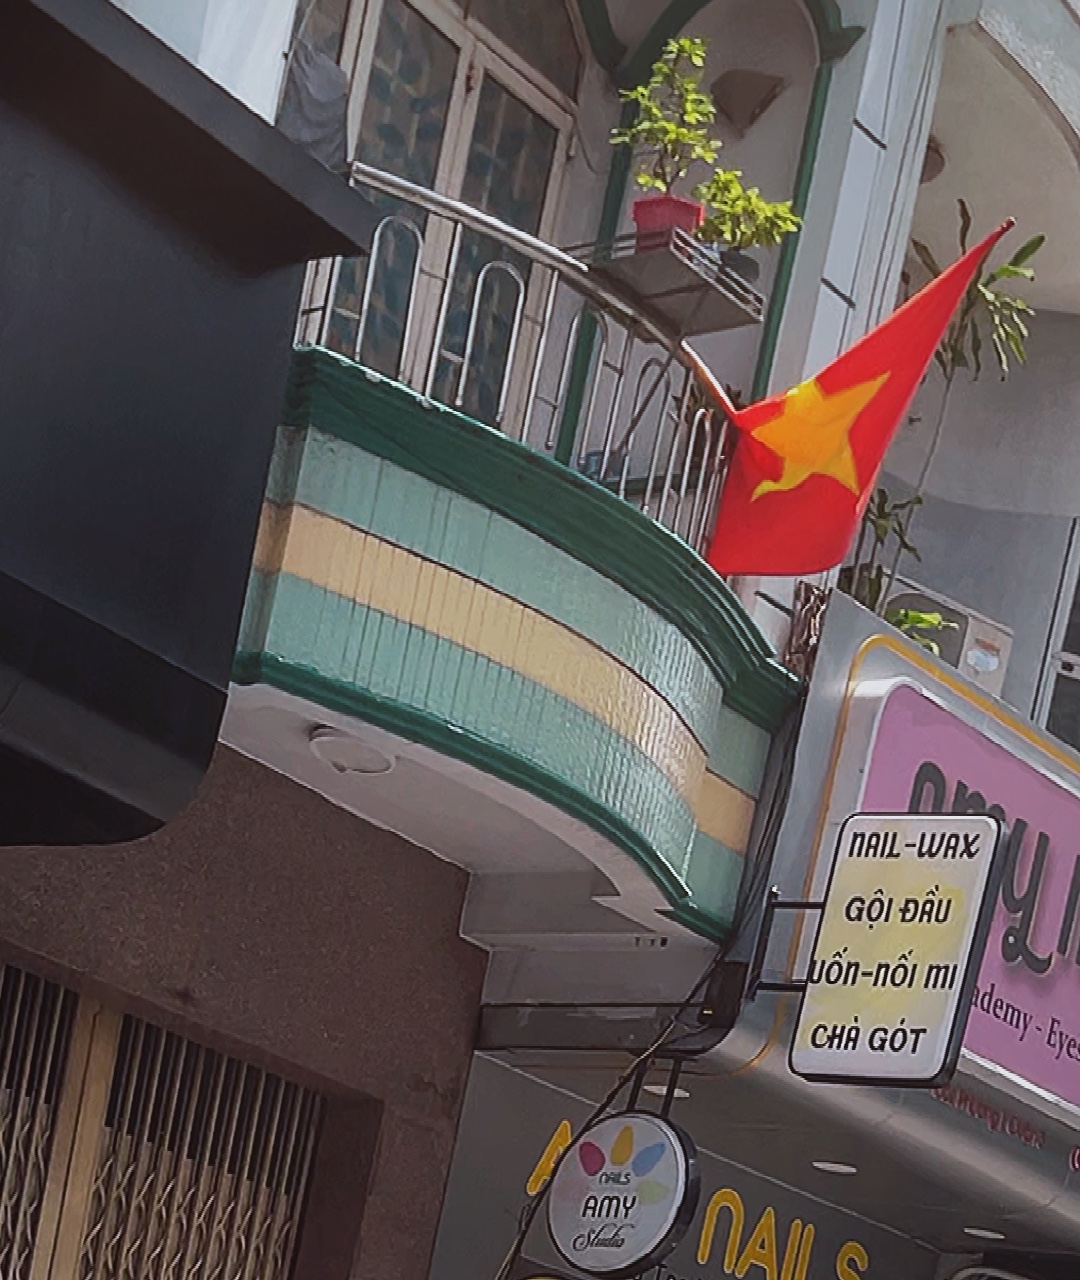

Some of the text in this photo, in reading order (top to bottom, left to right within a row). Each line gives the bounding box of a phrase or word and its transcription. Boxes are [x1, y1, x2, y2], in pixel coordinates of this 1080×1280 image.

[845, 884, 952, 930] GỘI ĐẦU
[809, 947, 958, 990] UỐN-NỐI MI
[811, 1015, 927, 1054] CHÀ GÓT
[598, 1171, 632, 1185] NAILS
[581, 1195, 637, 1219] AMY
